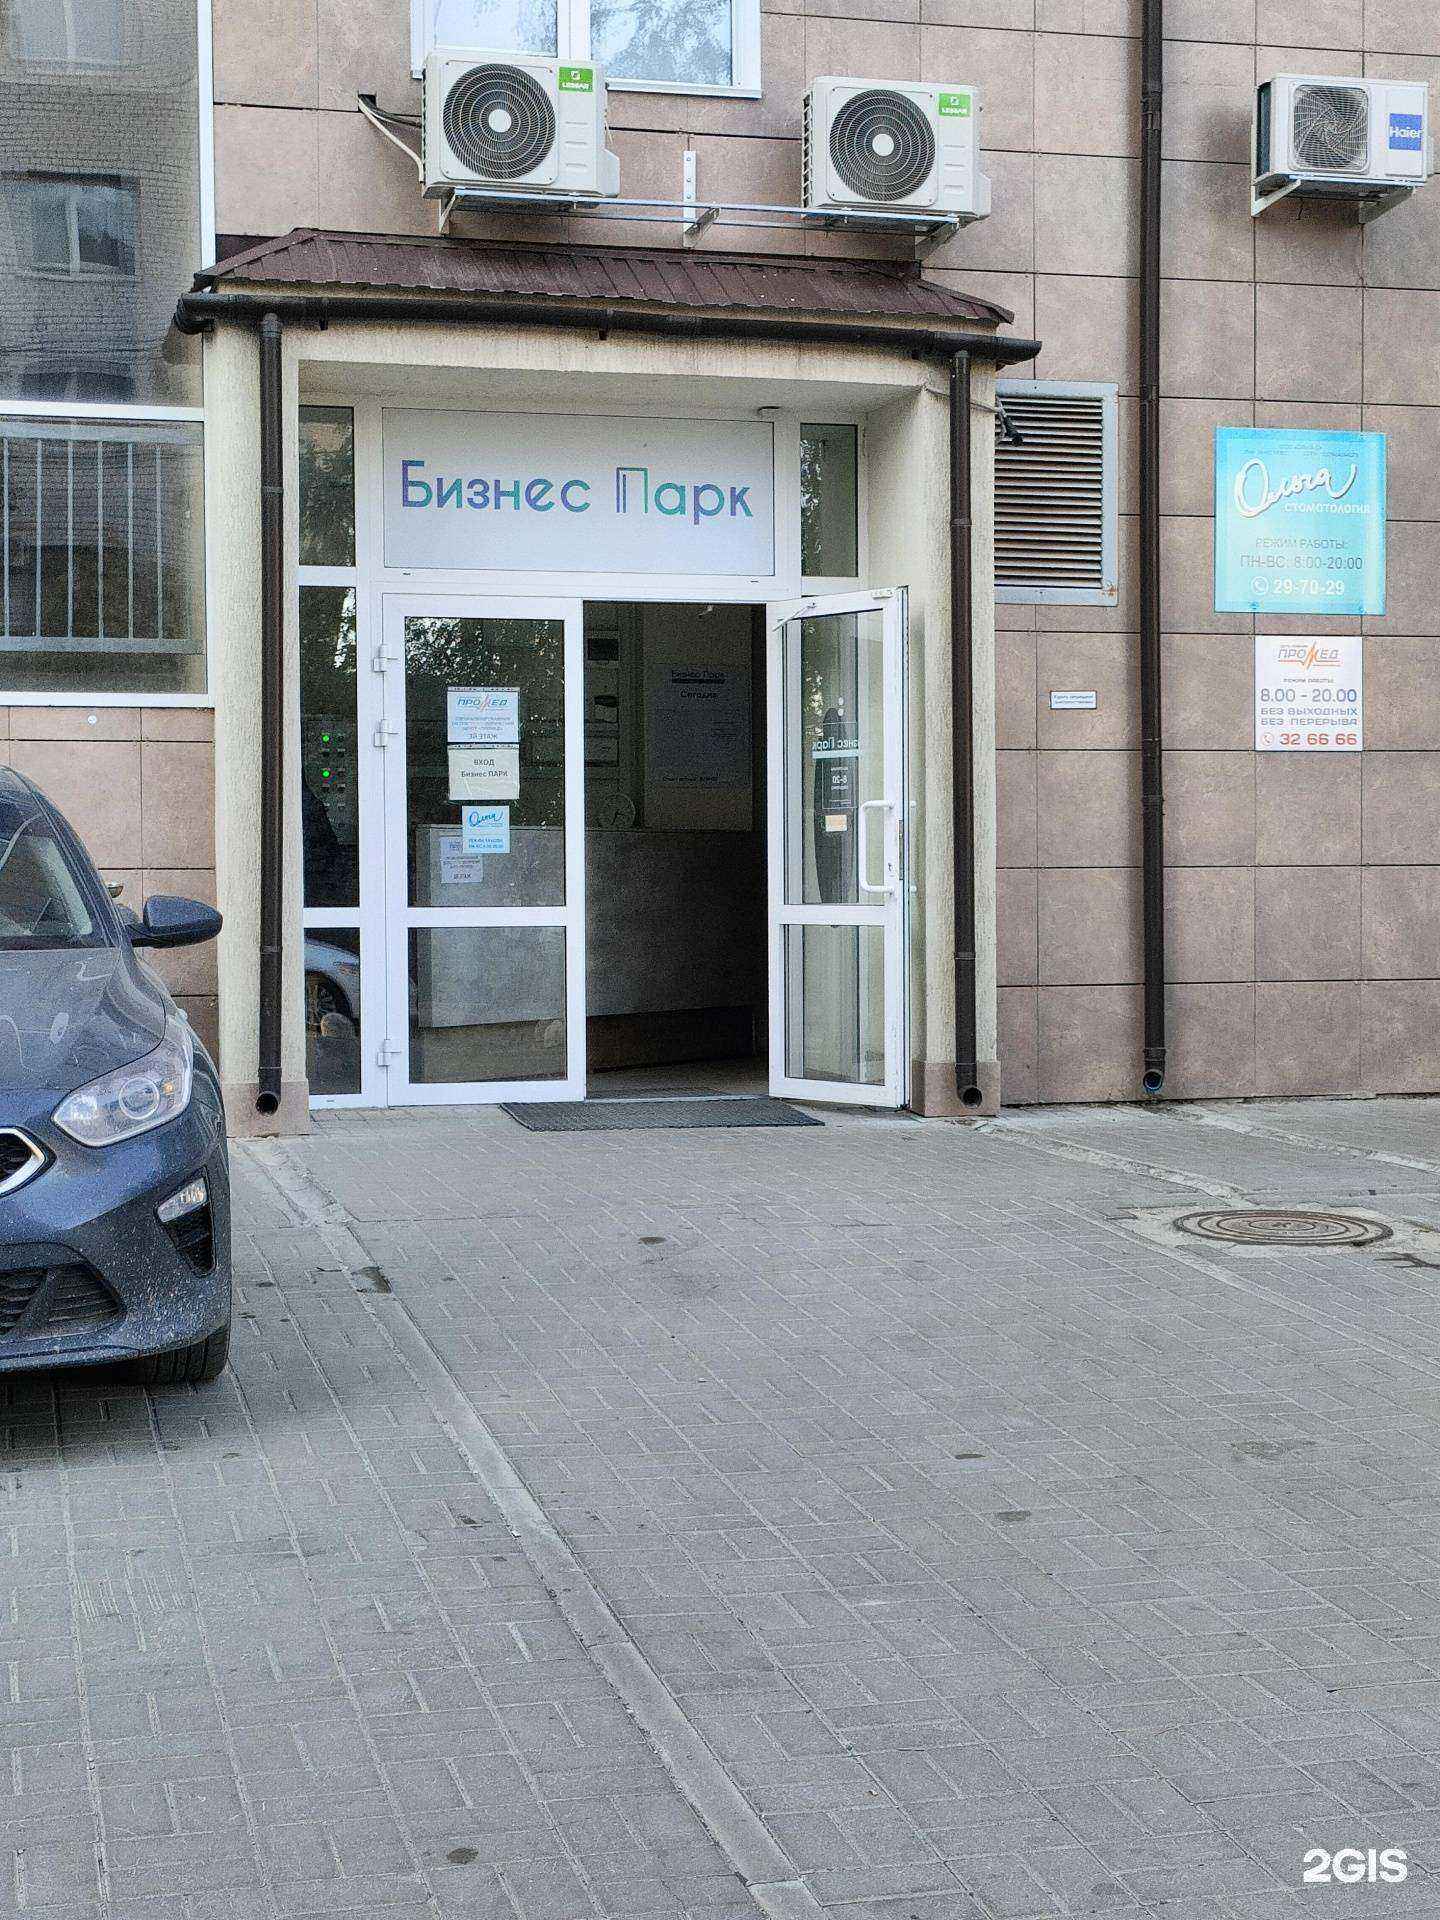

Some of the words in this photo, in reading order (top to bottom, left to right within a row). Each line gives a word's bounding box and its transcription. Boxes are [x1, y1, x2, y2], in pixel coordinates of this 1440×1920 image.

[1389, 126, 1423, 139] Haier
[401, 459, 591, 513] Бизнес
[616, 466, 754, 526] Парк
[1294, 556, 1363, 570] 8:00-20:00
[1272, 578, 1345, 596] 29-70-29
[1260, 688, 1296, 703] 8.00
[1312, 688, 1358, 703] 20.00
[1260, 707, 1285, 716] БЕЗ
[1287, 708, 1359, 717] ВЫХОДНЫХ
[1260, 718, 1285, 726] БЕЗ
[1291, 718, 1358, 726] ПЕРЕРЫВА
[1279, 733, 1301, 746] 32
[1306, 733, 1329, 746] 66
[1335, 733, 1358, 746] 66
[473, 759, 495, 767] ВХОД
[461, 770, 487, 778] Бизнес
